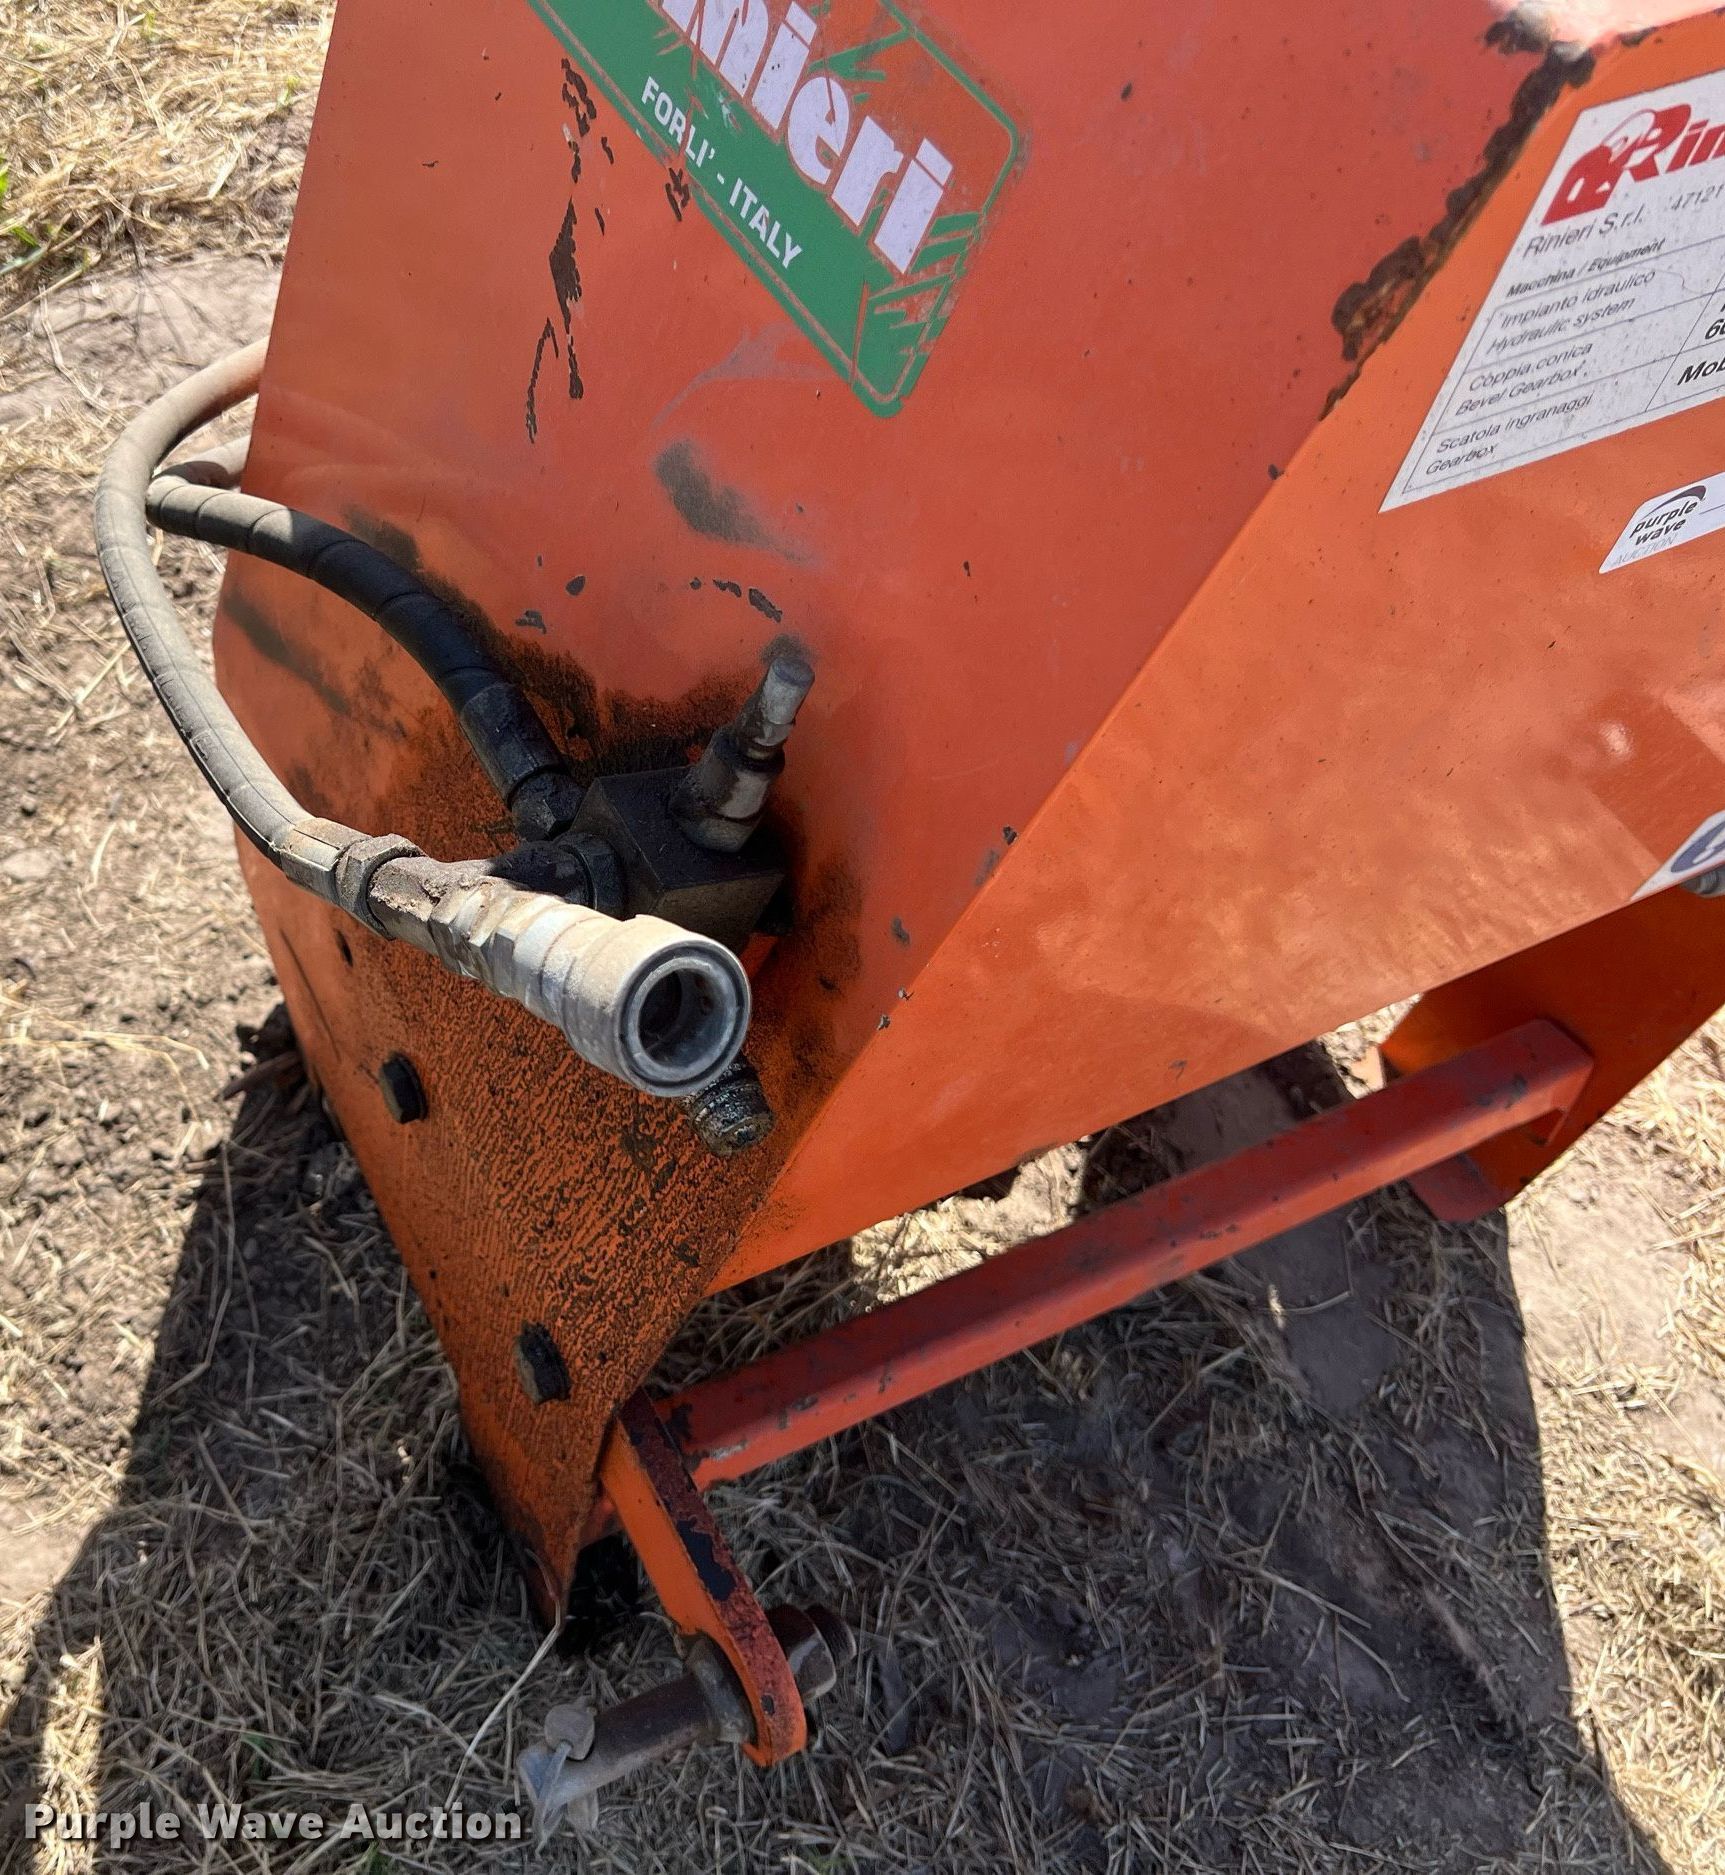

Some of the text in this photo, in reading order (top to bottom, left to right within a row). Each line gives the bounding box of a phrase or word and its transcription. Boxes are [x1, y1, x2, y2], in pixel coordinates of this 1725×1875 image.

[660, 0, 954, 275] nieri
[729, 178, 802, 269] ITALY
[1523, 218, 1597, 258] Rinieri
[1599, 203, 1645, 233] S.r.l.
[1507, 267, 1575, 297] Macchina
[1587, 237, 1666, 272] Equipment
[1486, 298, 1635, 355] Hydraulic system
[1501, 294, 1579, 328] Impianto
[1456, 363, 1583, 416] Bevel Gearbox
[1469, 343, 1593, 392] Coppia conica
[1438, 391, 1595, 453] Scatola ingranaggi
[1426, 443, 1499, 475] Gearbox
[1629, 500, 1698, 539] purple
[1635, 519, 1686, 545] wave
